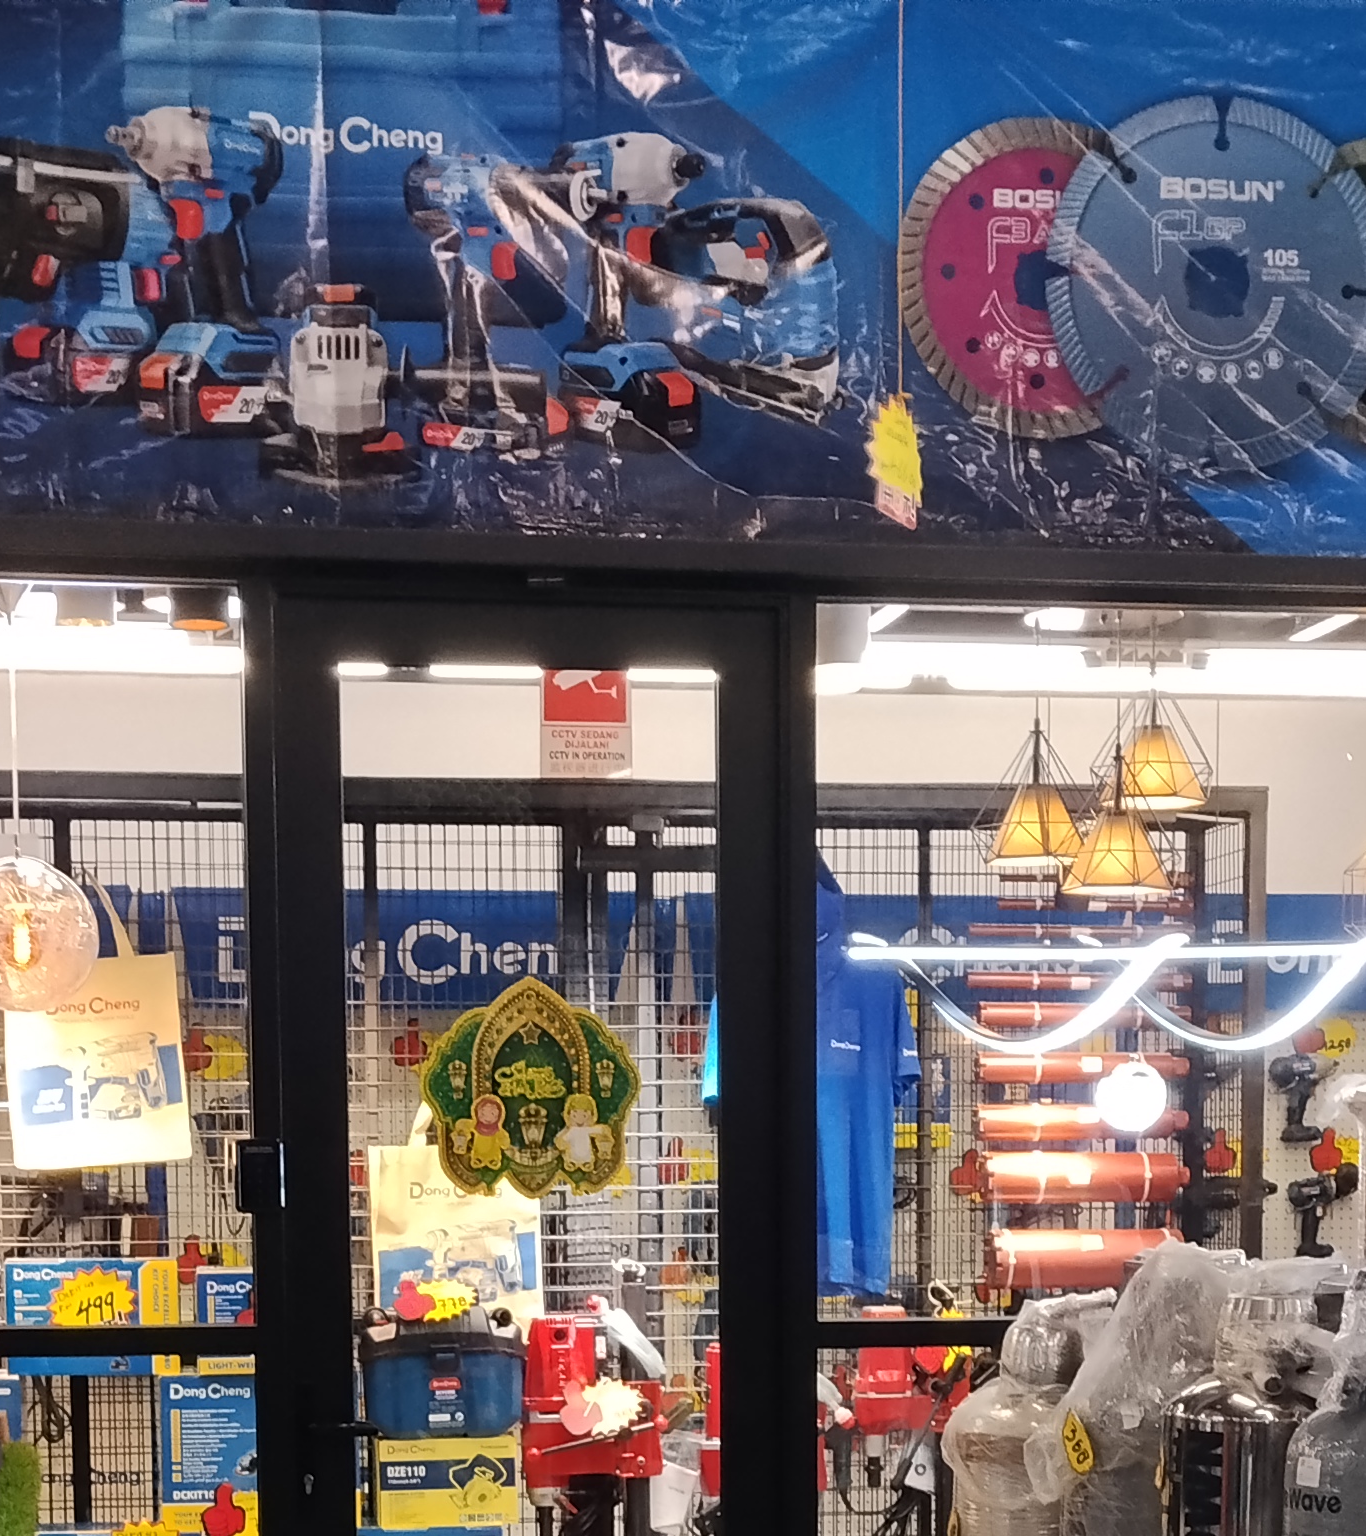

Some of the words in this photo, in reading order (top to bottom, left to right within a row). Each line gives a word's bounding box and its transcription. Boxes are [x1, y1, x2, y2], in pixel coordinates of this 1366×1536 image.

[992, 187, 1062, 209] BOS
[1263, 249, 1300, 267] 105
[551, 729, 578, 739] CCTV
[580, 730, 619, 740] SEDANG
[549, 750, 570, 760] CCTV
[572, 751, 580, 760] IN
[582, 751, 626, 761] OPERATION
[397, 918, 559, 986] Chen
[75, 1290, 116, 1325] 499
[386, 1464, 426, 1478] DZE110
